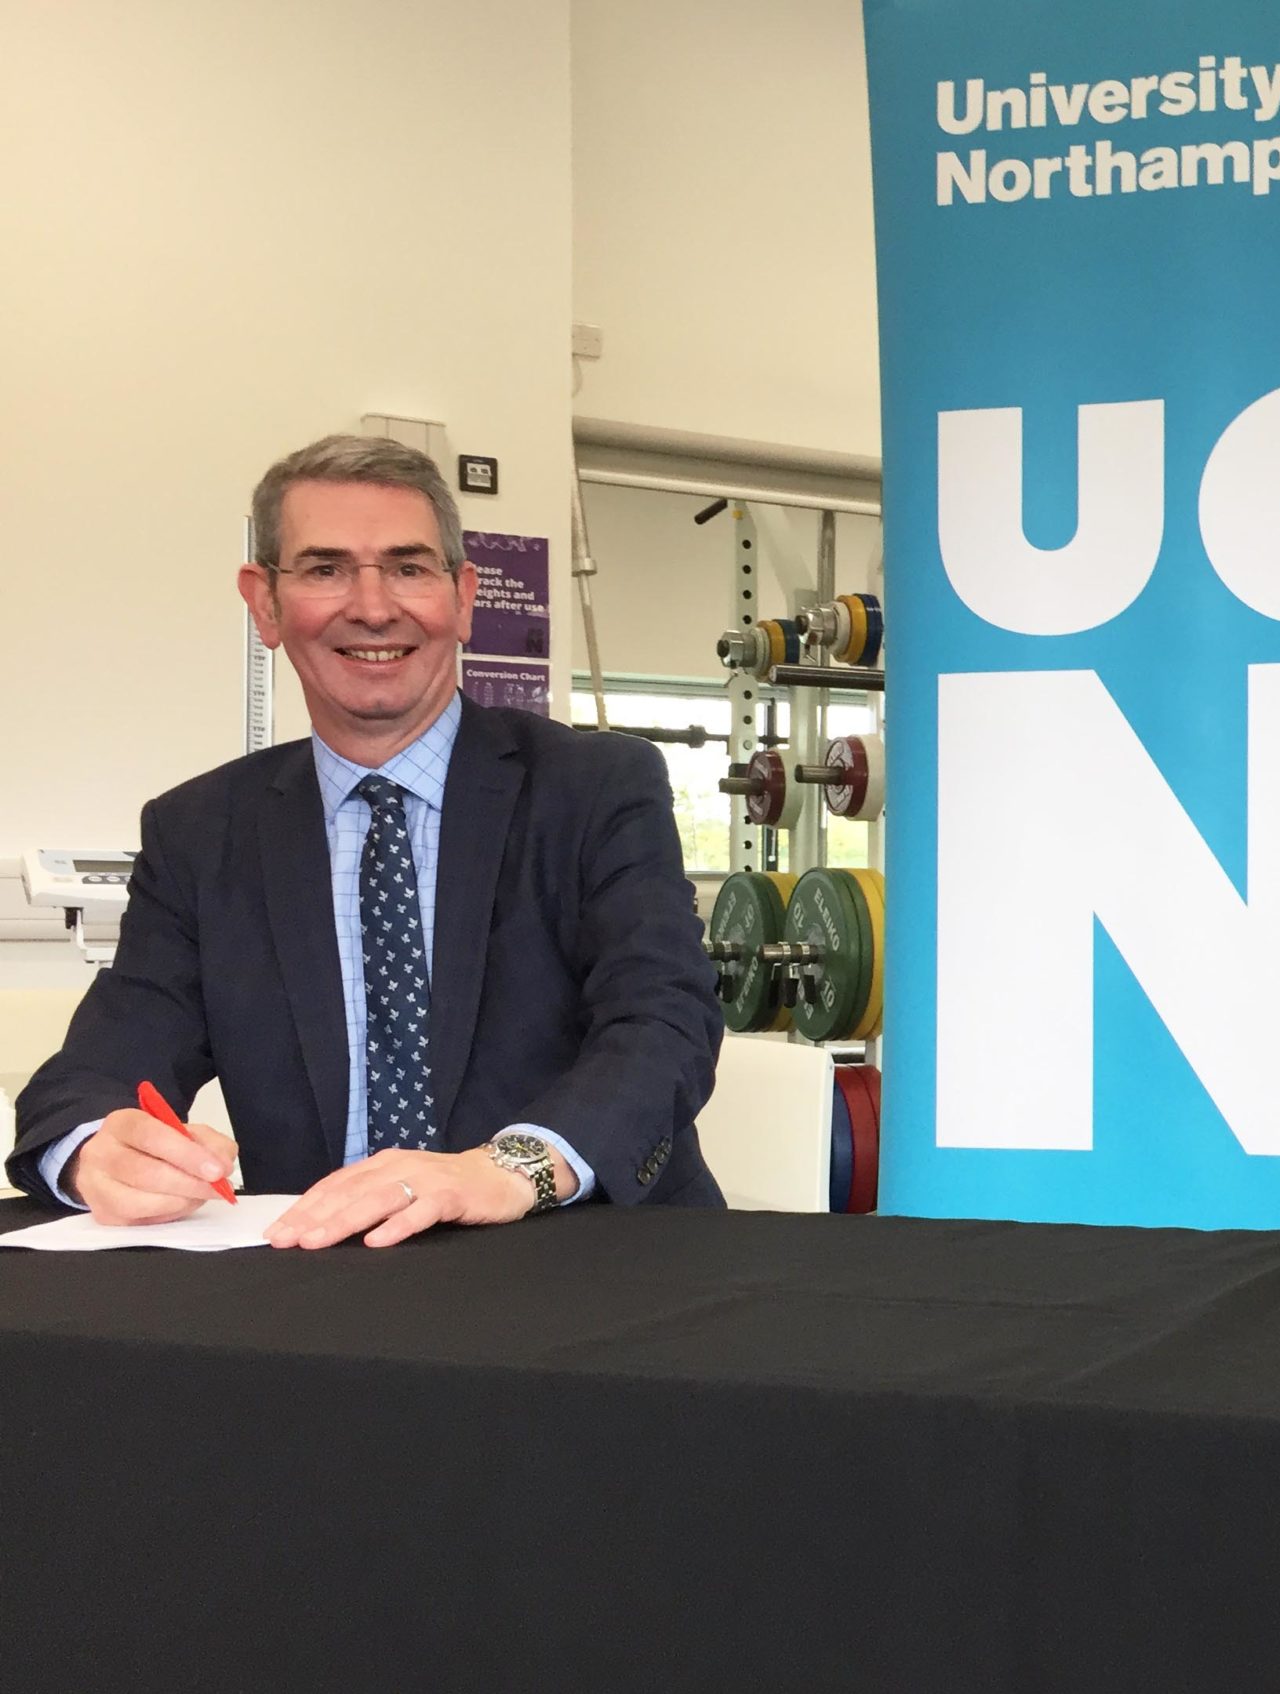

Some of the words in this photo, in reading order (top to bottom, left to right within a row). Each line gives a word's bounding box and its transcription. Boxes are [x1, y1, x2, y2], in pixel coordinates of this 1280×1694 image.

[504, 578, 525, 589] the
[513, 591, 535, 601] and
[493, 600, 522, 611] after
[524, 603, 545, 613] use
[466, 669, 519, 680] Conversion
[520, 672, 546, 682] Chart
[814, 887, 840, 952] ELEIKO
